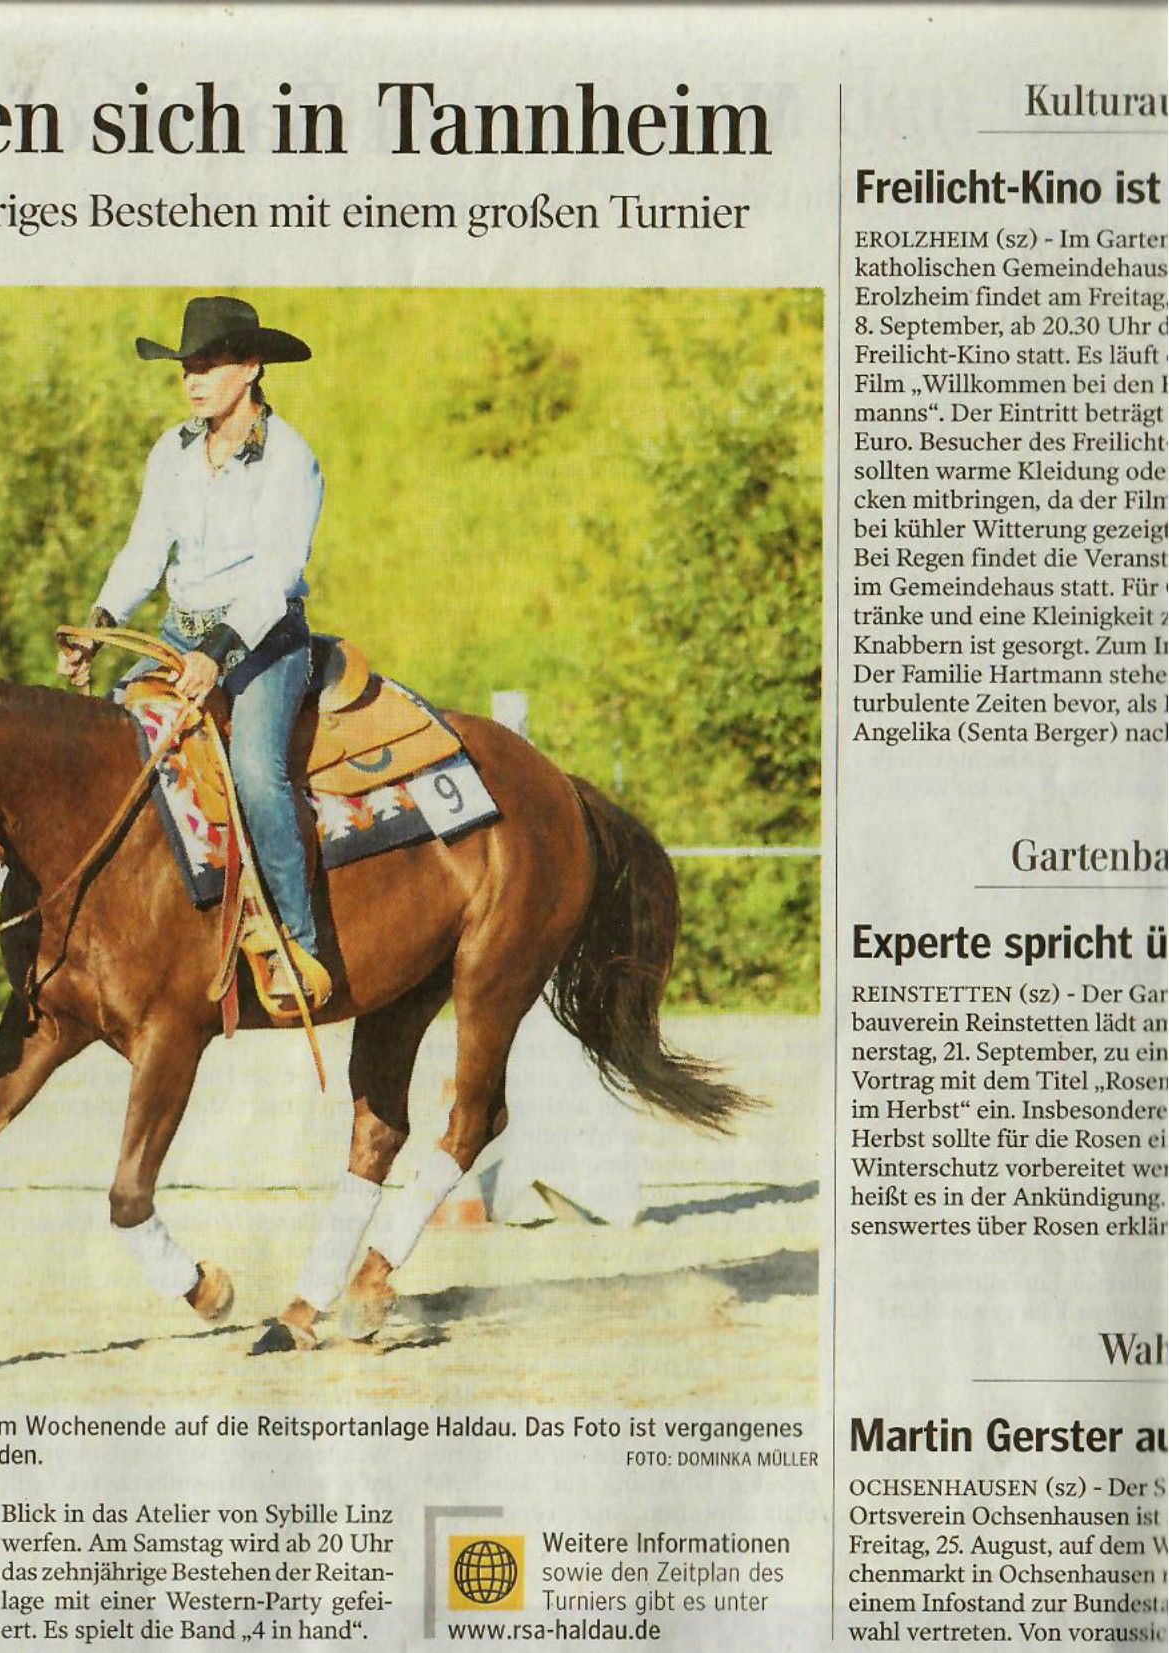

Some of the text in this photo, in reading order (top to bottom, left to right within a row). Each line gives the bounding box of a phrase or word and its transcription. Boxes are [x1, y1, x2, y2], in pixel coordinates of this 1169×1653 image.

[92, 81, 246, 155] sich
[271, 81, 349, 155] in
[377, 82, 773, 157] Tannheim
[856, 168, 1162, 205] Freilicht-Kino ist
[88, 191, 259, 228] Bestehen
[268, 193, 332, 228] mit
[342, 194, 458, 229] einem
[467, 192, 600, 239] großen
[608, 194, 751, 229] Turnier
[854, 256, 1168, 278] katholischen Gemeindehaus
[853, 546, 1168, 573] Bei Regen findet die Veranst
[433, 773, 465, 814] 9
[1011, 838, 1168, 873] Gartenba
[852, 923, 1168, 967] Experte spricht ü
[851, 985, 1013, 1003] REINSTETTEN
[1019, 982, 1061, 1006] (sz)
[1081, 983, 1124, 1004] Der
[25, 1414, 166, 1437] Wochenende
[174, 1414, 210, 1437] auf
[216, 1414, 249, 1437] die
[257, 1414, 430, 1442] Reitsportanlage
[436, 1415, 517, 1438] Haldau.
[525, 1415, 565, 1438] Das
[573, 1415, 621, 1439] Foto
[629, 1416, 657, 1438] ist
[664, 1421, 804, 1443] vergangenes
[850, 1417, 973, 1453] Martin
[986, 1417, 1124, 1454] Gerster
[626, 1448, 819, 1467] FOTO: DOMINKA MÜLLER
[849, 1478, 1038, 1498] OCHSENHAUSEN
[1045, 1475, 1087, 1499] (sz)
[1107, 1477, 1149, 1499] Der
[0, 1502, 394, 1529] Blick in das Atelier von Sybille Linz
[849, 1504, 1160, 1528] Ortsverein Ochsenhausen ist
[0, 1531, 394, 1559] werfen. Am Samstag wird ab 20 Uhr
[541, 1531, 790, 1554] Weitere Informationen
[542, 1560, 784, 1587] sowie den Zeitplan des
[542, 1589, 769, 1617] Turniers gibt es unter
[447, 1618, 661, 1641] www.rsa-haldau.de
